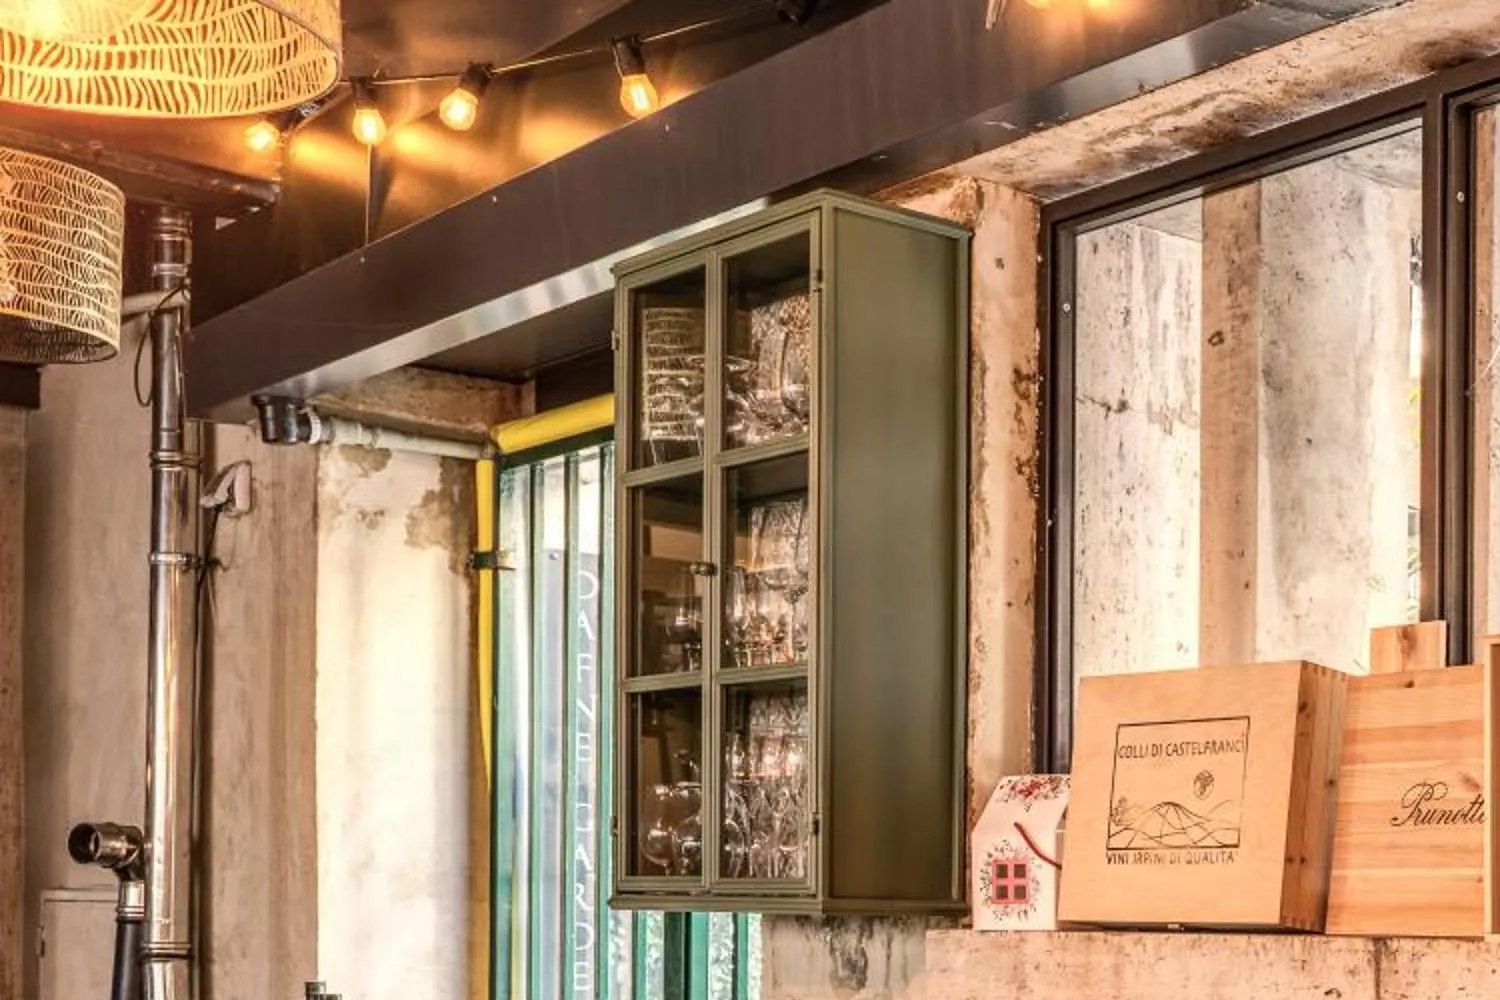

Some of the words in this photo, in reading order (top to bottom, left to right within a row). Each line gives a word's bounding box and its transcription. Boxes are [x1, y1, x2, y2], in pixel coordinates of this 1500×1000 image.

[1118, 744, 1149, 759] COLLI
[1151, 743, 1163, 757] DI
[1106, 851, 1129, 865] VINI
[1169, 850, 1181, 865] DI
